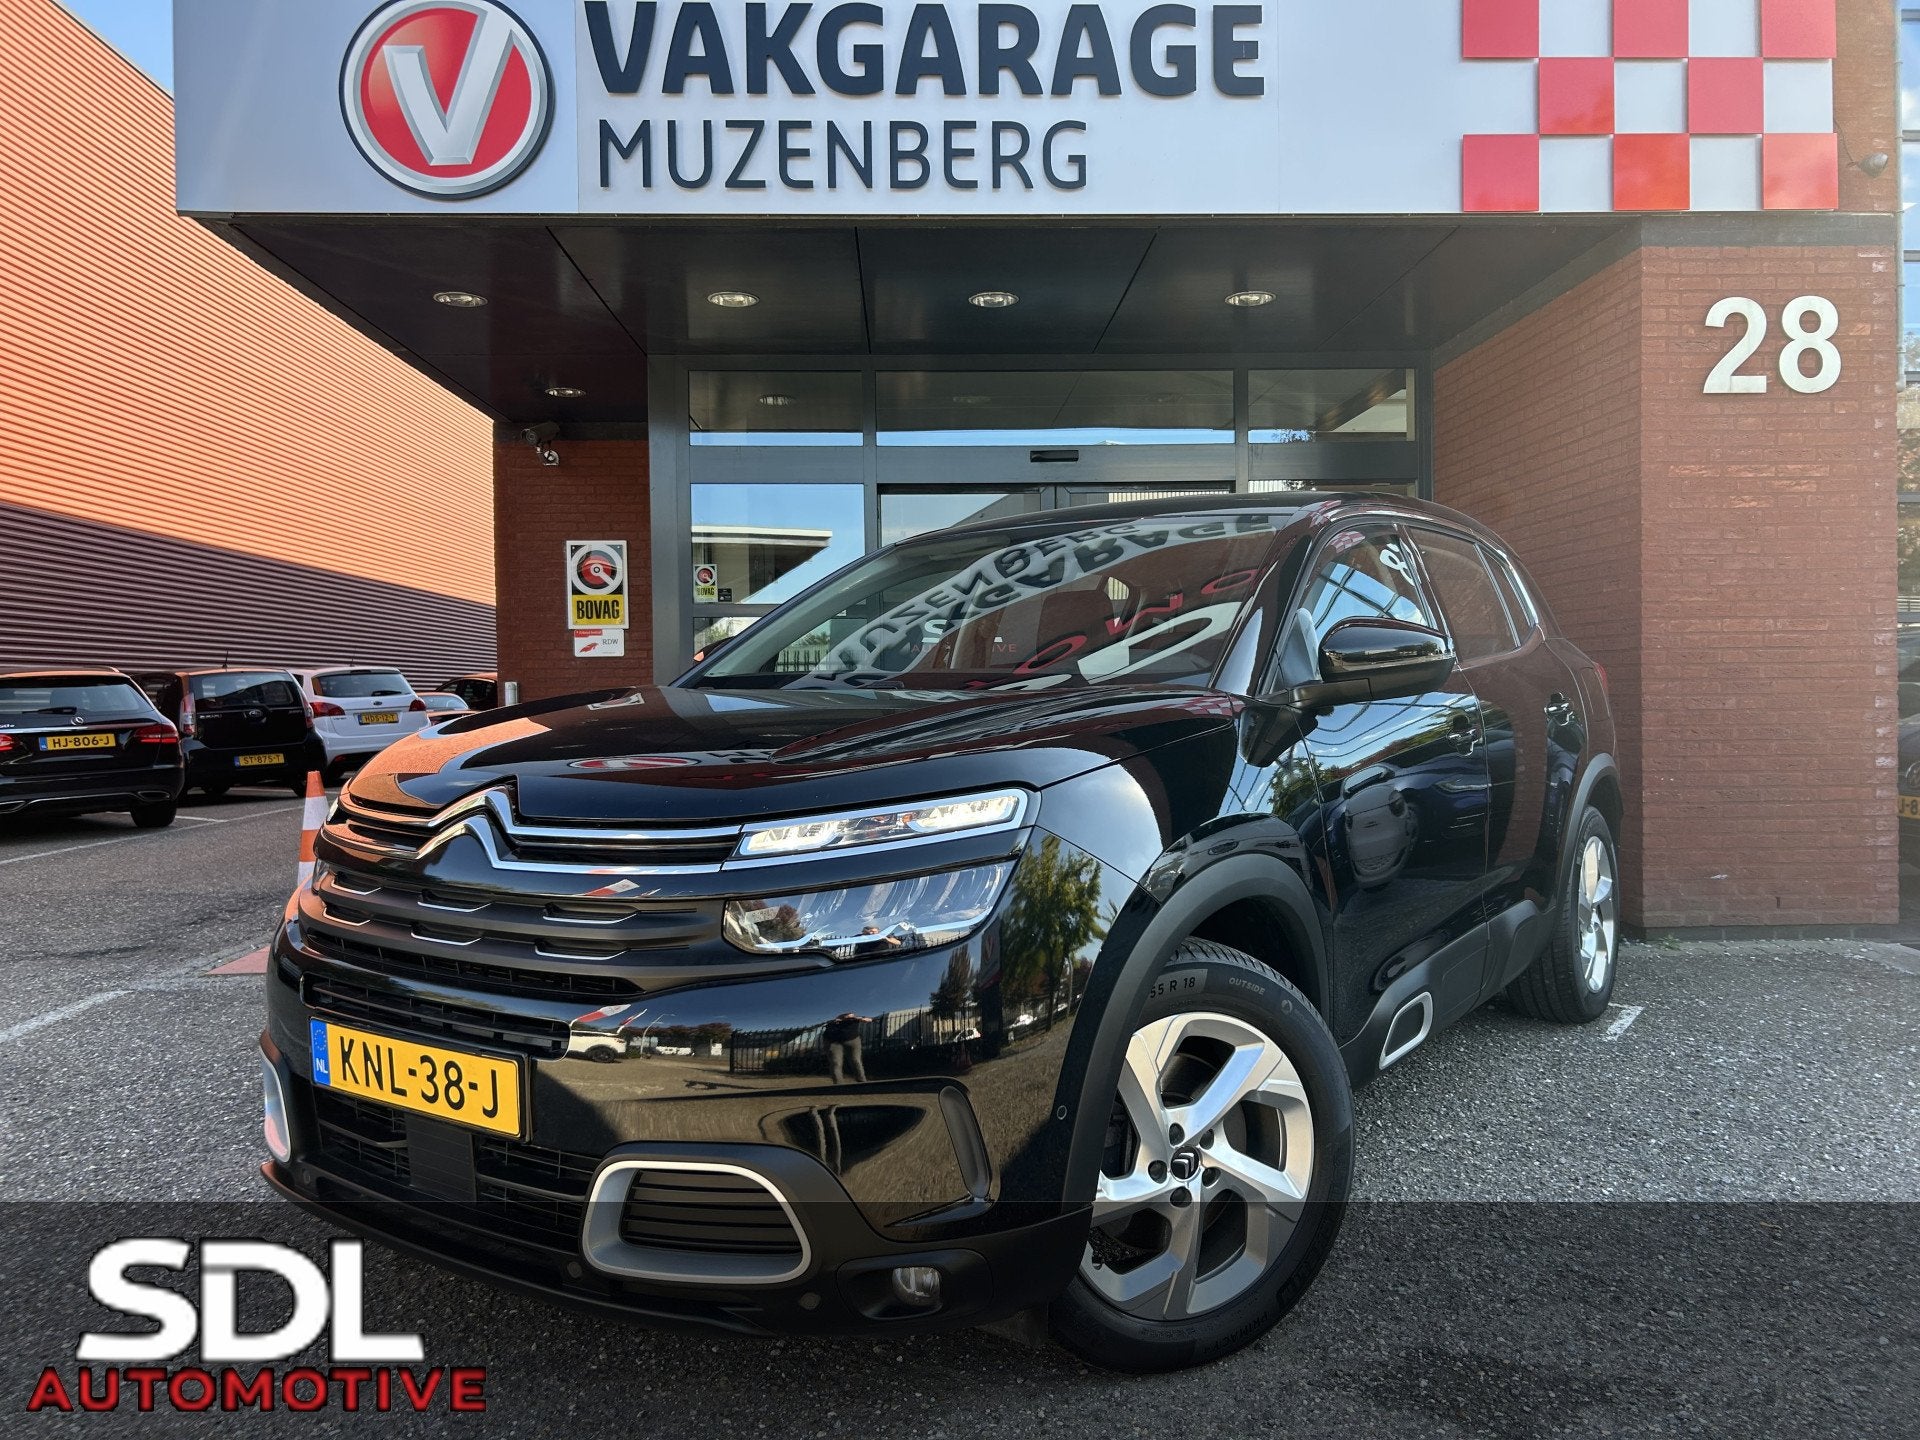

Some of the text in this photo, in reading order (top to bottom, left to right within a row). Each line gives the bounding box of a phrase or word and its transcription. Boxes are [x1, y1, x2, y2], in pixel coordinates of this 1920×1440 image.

[584, 1, 1265, 96] VAKGARAGE
[598, 118, 1088, 190] MUZENBERG
[1702, 295, 1842, 394] 28
[576, 599, 620, 620] BOVAG
[52, 736, 110, 749] HJ-806-J
[243, 755, 281, 765] ST-875-T
[1169, 980, 1178, 992] R
[1183, 977, 1196, 989] 18
[1228, 977, 1266, 996] OUTSIDE
[316, 1057, 328, 1074] NL
[339, 1036, 499, 1119] KNL-38-J
